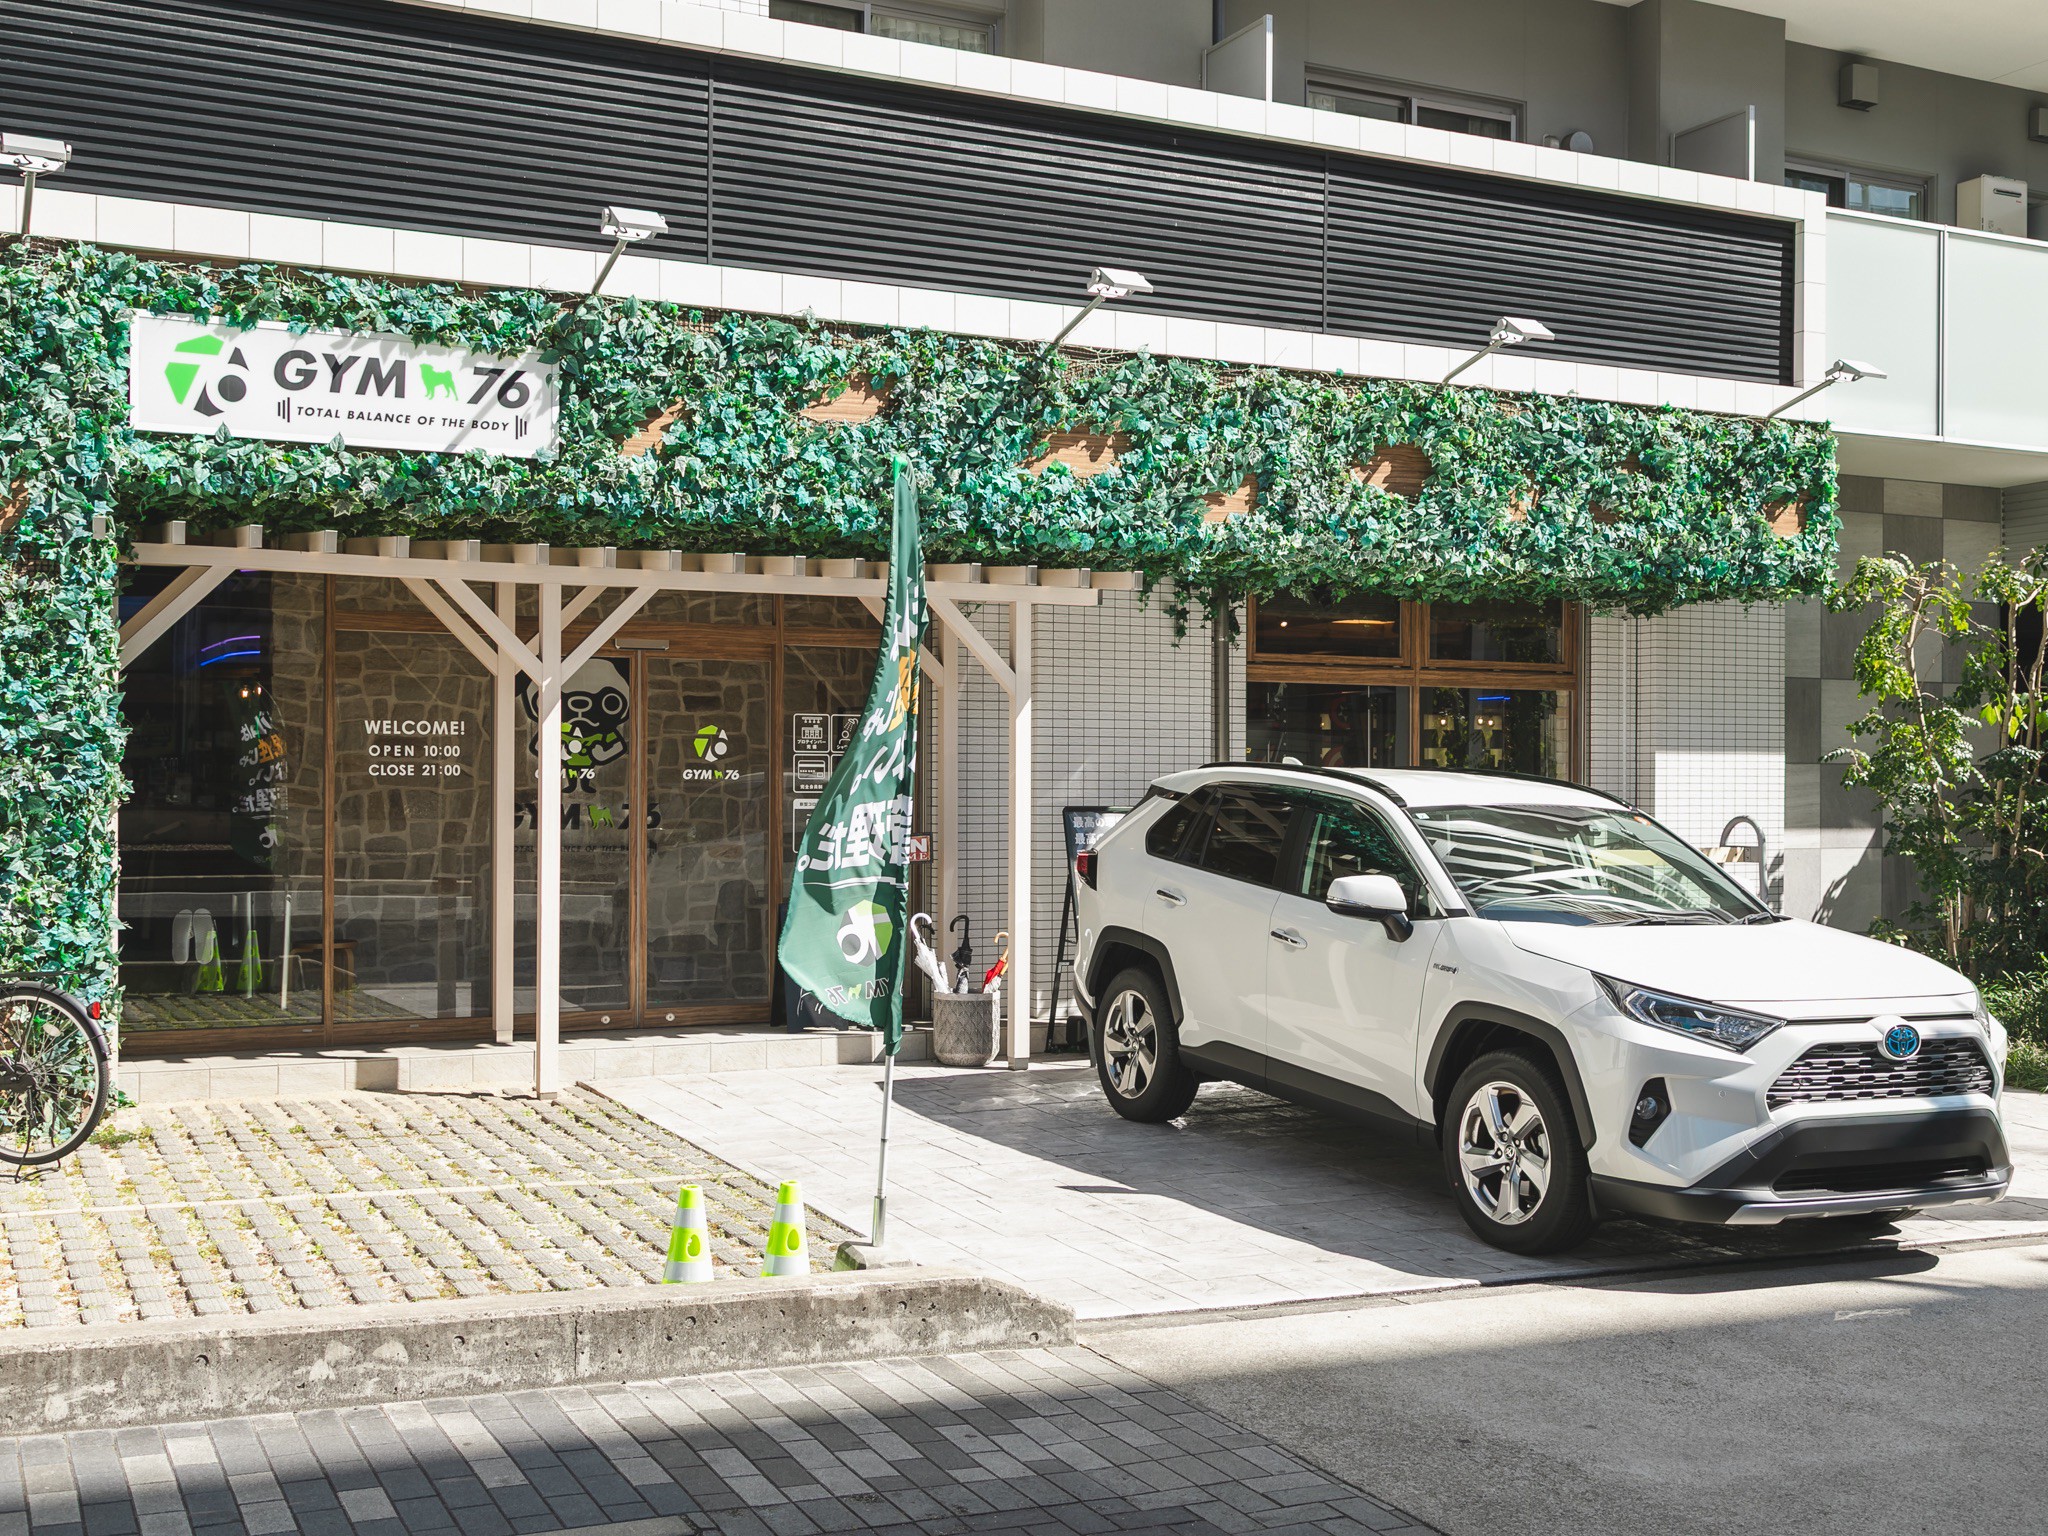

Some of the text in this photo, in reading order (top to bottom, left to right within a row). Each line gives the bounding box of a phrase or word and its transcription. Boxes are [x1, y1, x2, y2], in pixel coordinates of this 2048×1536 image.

[273, 349, 531, 409] GYM 76
[296, 405, 510, 432] TOTAL BALANCE OF THE BODY
[364, 719, 466, 736] WELCOME!
[368, 744, 461, 757] OPEN 10:00
[368, 764, 461, 777] CLOSE 21:00
[579, 768, 596, 780] 76
[682, 768, 740, 781] GYM 76
[1073, 816, 1119, 829] 最高の
